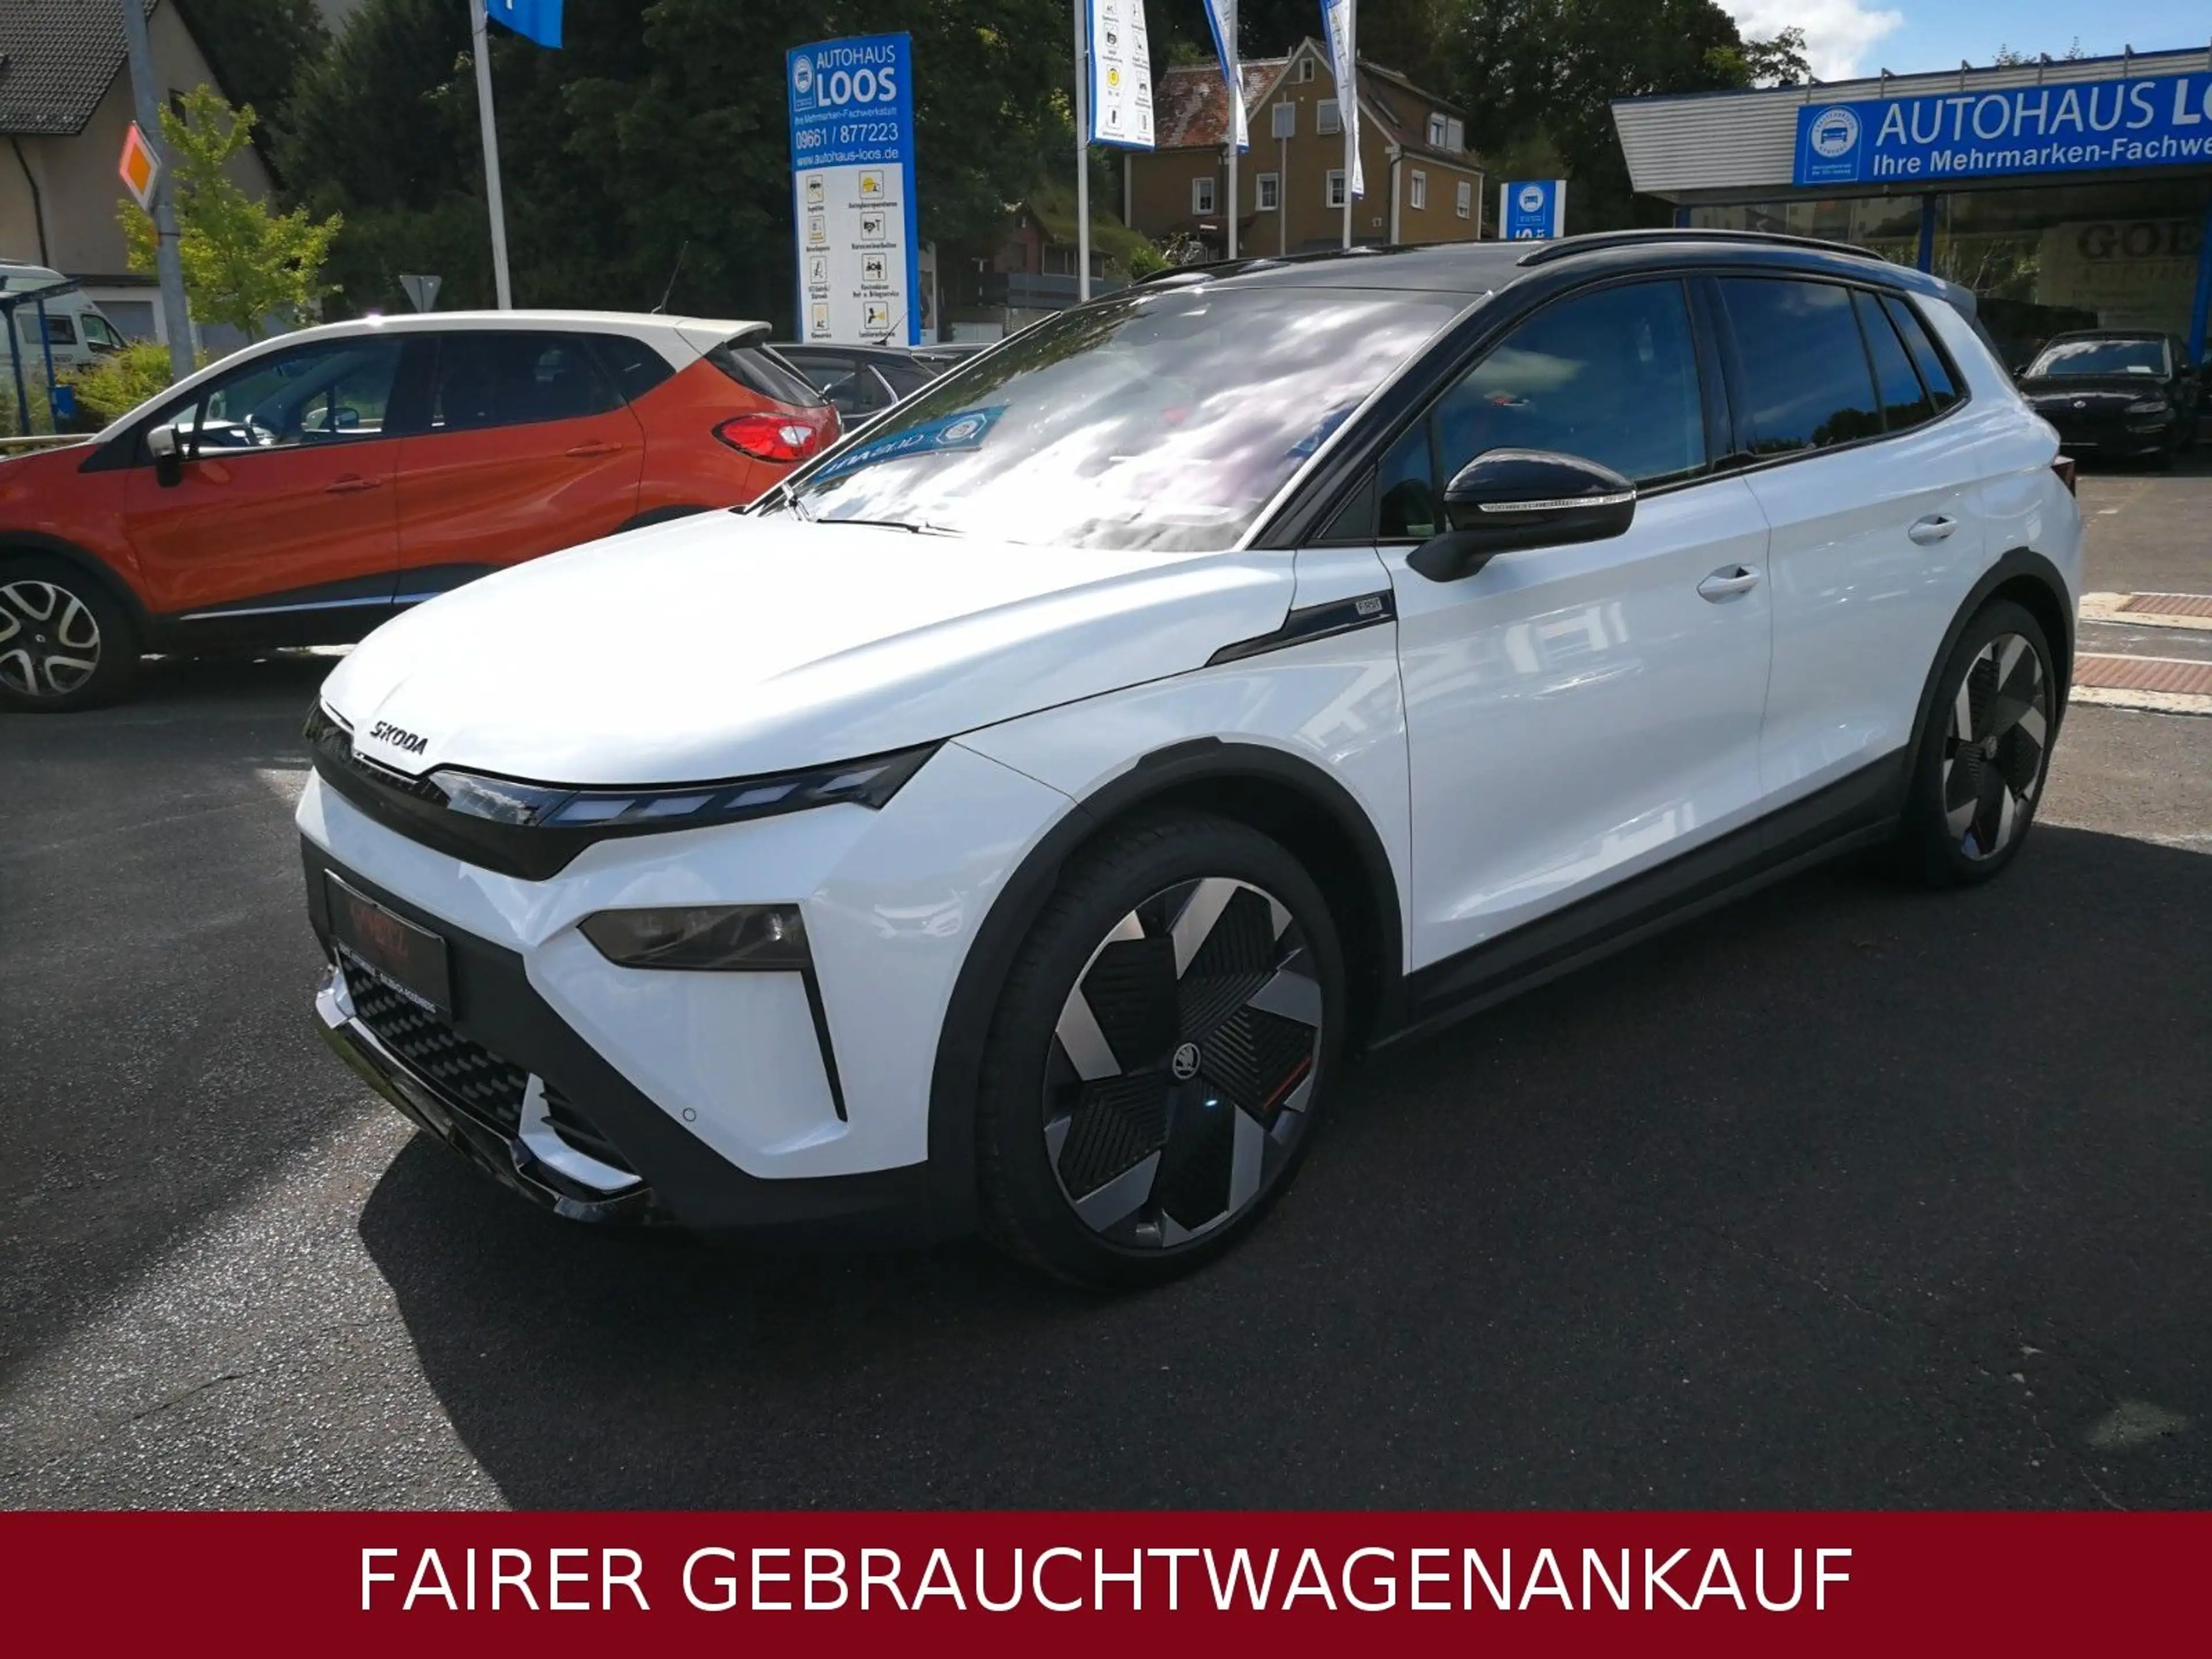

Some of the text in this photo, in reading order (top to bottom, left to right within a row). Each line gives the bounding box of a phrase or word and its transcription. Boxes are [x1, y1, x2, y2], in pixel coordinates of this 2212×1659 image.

[816, 45, 895, 69] AUTOHAUS
[816, 66, 897, 107] LOOS
[1875, 81, 2157, 146] AUTOHAUS
[796, 127, 828, 149] 09661
[840, 123, 899, 143] 877223
[796, 146, 899, 167] www.autohaus-loos.de
[1873, 154, 1921, 176] Ihre
